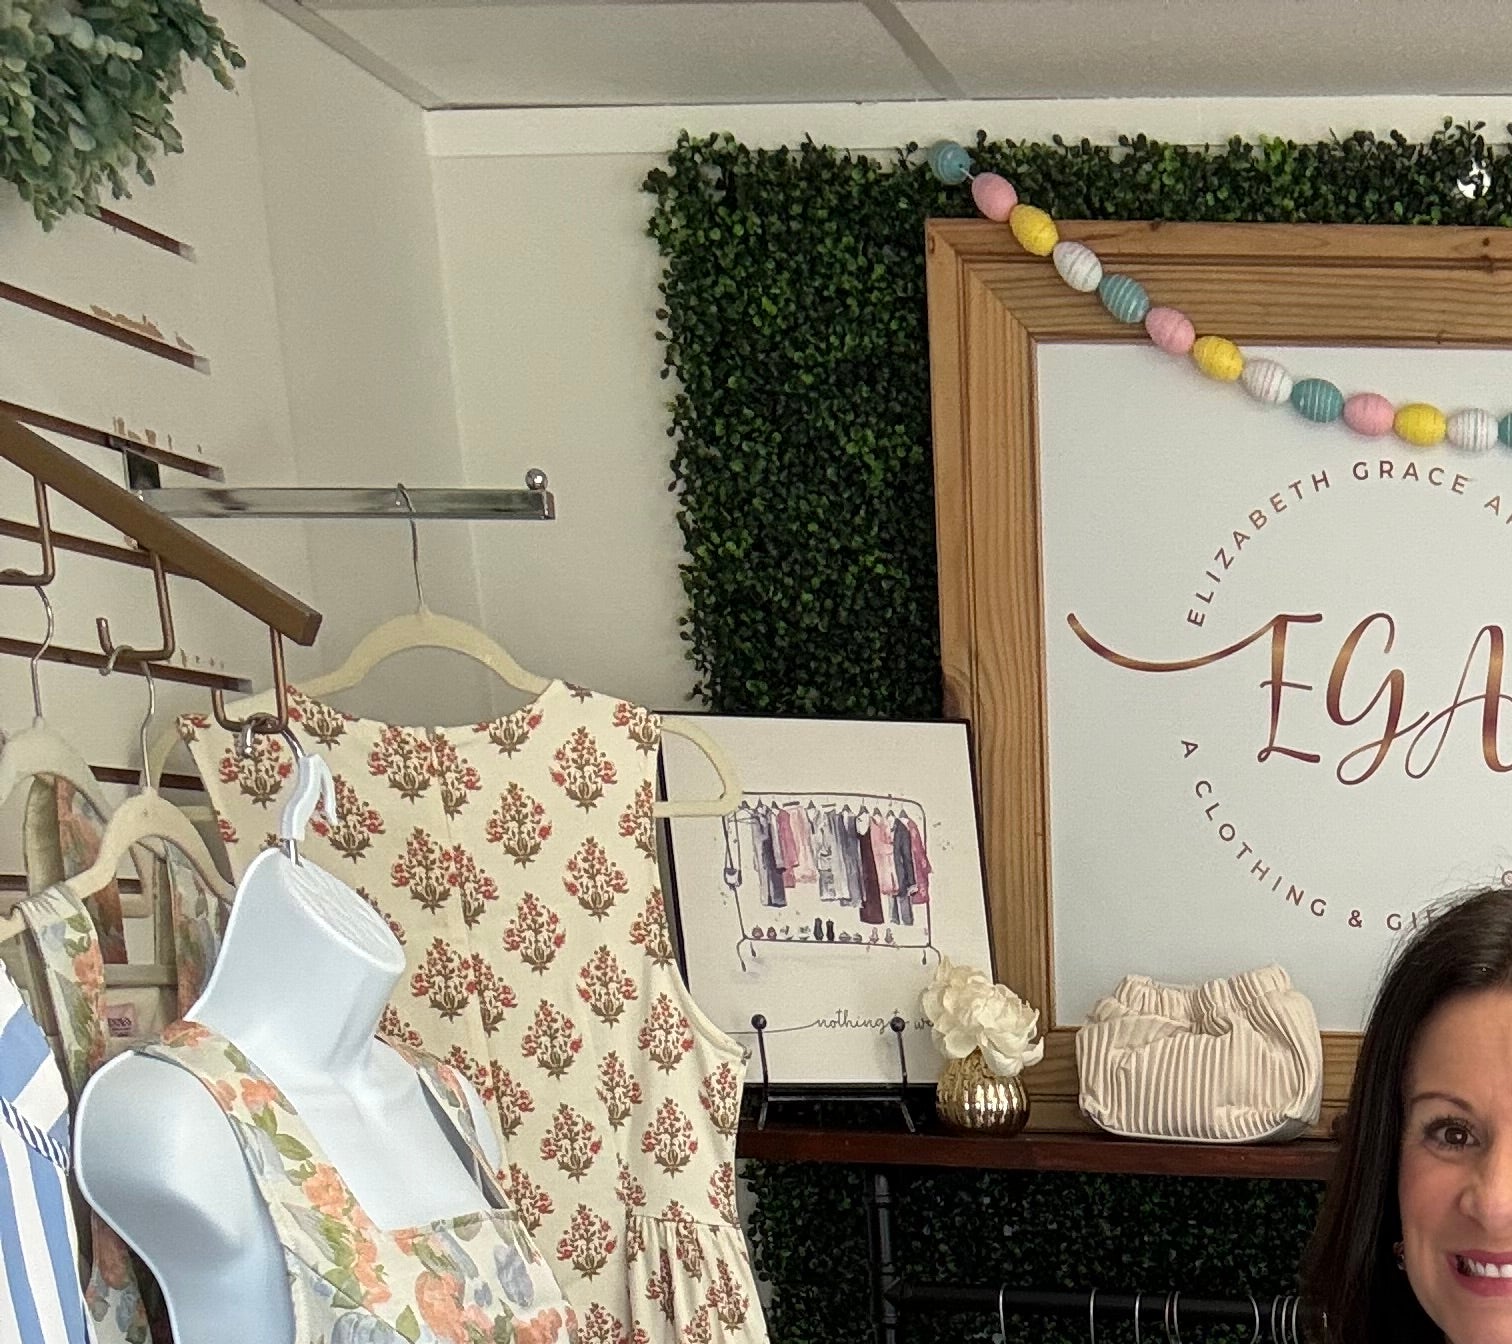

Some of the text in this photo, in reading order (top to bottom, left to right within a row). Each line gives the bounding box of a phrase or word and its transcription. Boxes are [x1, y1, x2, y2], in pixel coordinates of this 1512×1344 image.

[1186, 470, 1331, 628] ELIZABETH
[1353, 460, 1470, 496] GRACE
[1181, 739, 1199, 759] A
[1195, 781, 1327, 917] CLOTHING
[1348, 909, 1363, 929] &
[1386, 907, 1438, 931] GIF
[814, 1008, 888, 1035] nothing
